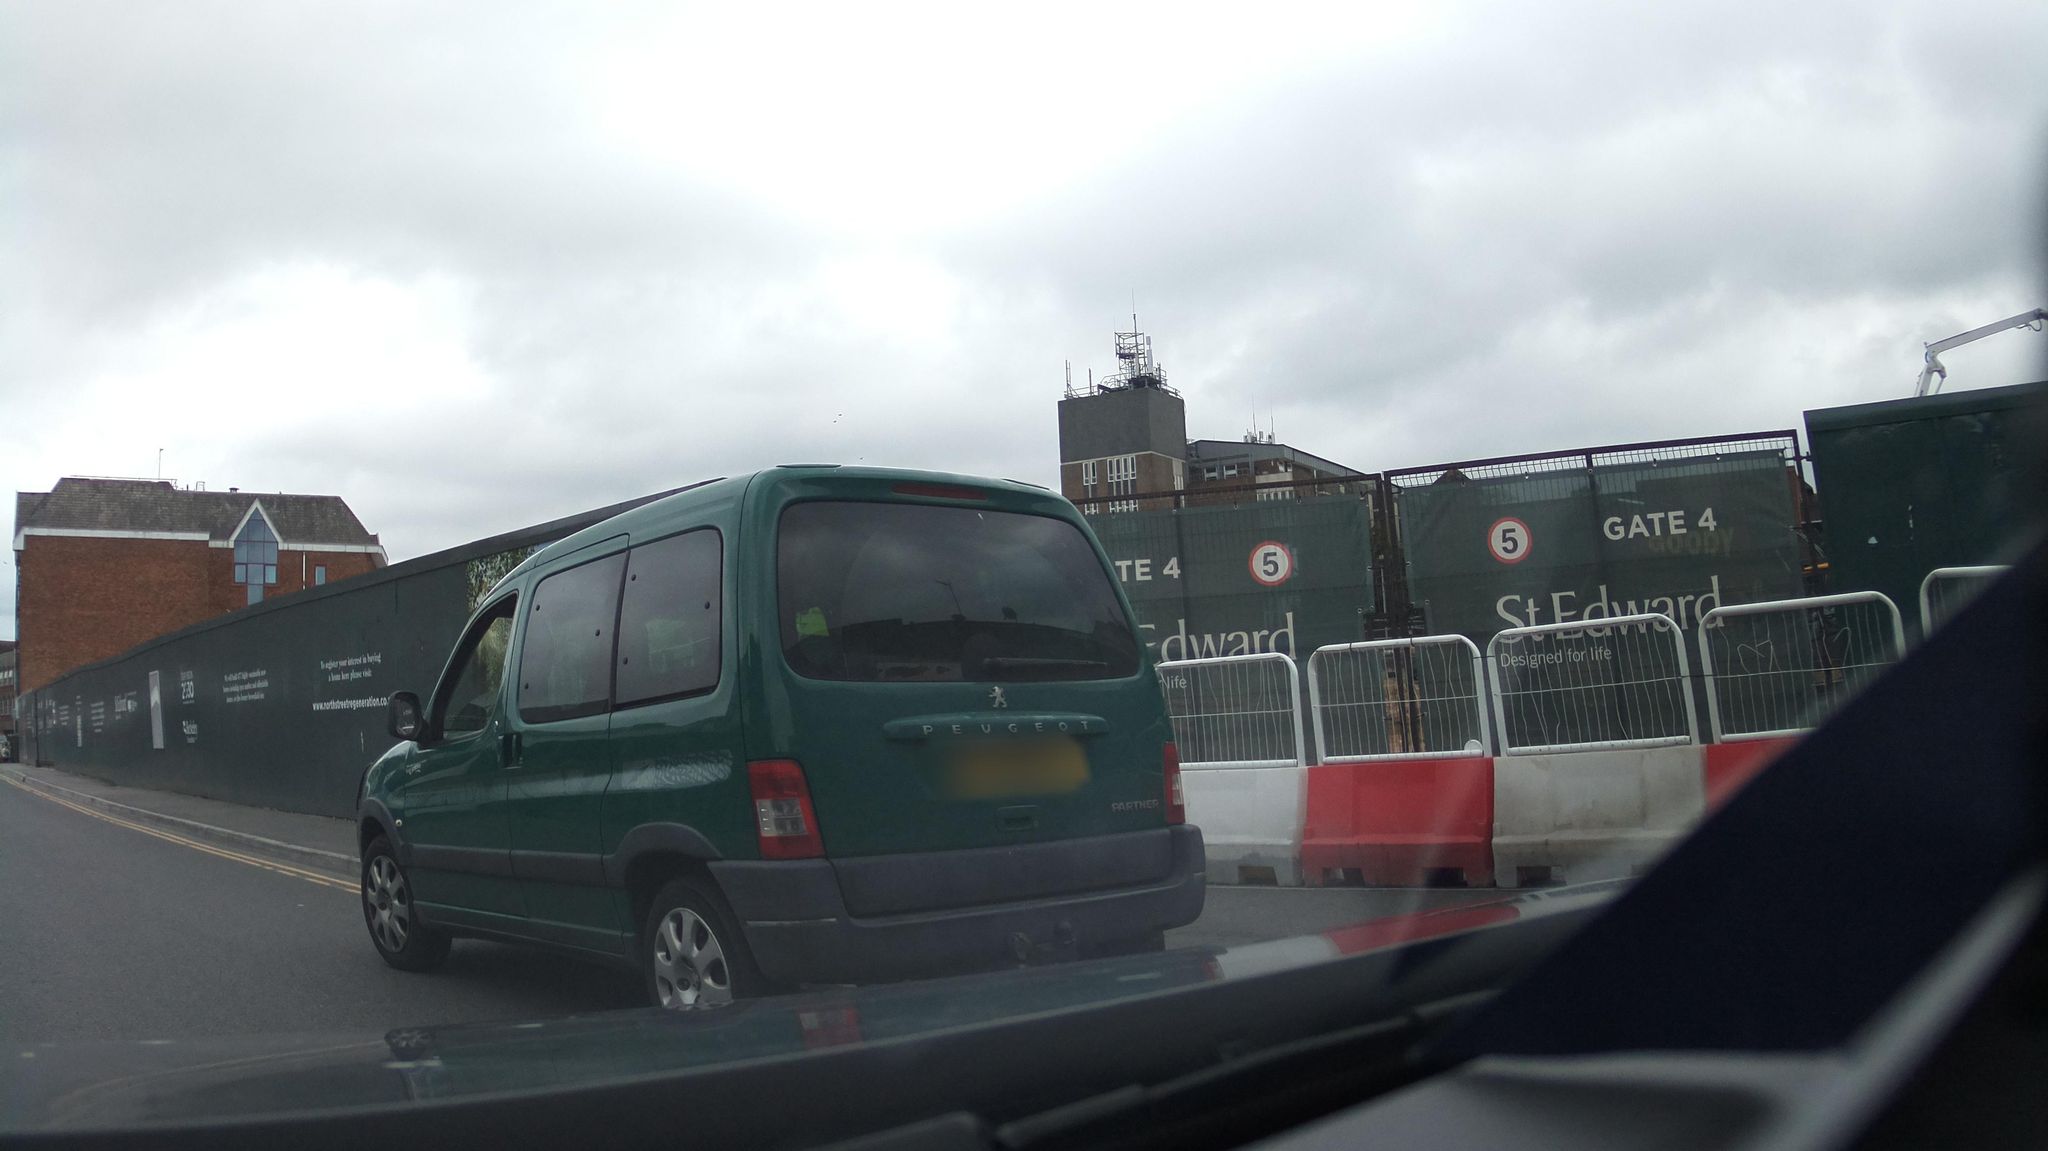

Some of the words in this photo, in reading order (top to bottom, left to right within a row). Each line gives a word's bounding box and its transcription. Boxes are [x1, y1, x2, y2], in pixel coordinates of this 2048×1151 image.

[1603, 510, 1688, 540] GATE
[1698, 507, 1717, 532] 4
[1501, 527, 1519, 554] 5
[1163, 557, 1181, 579] 4
[1262, 551, 1279, 576] 5
[1551, 575, 1725, 640] Edward
[1501, 647, 1562, 669] Designed
[1567, 646, 1587, 662] for
[1591, 646, 1612, 661] life
[923, 721, 1089, 736] PEUGEOT
[1112, 799, 1159, 812] PARTNER
